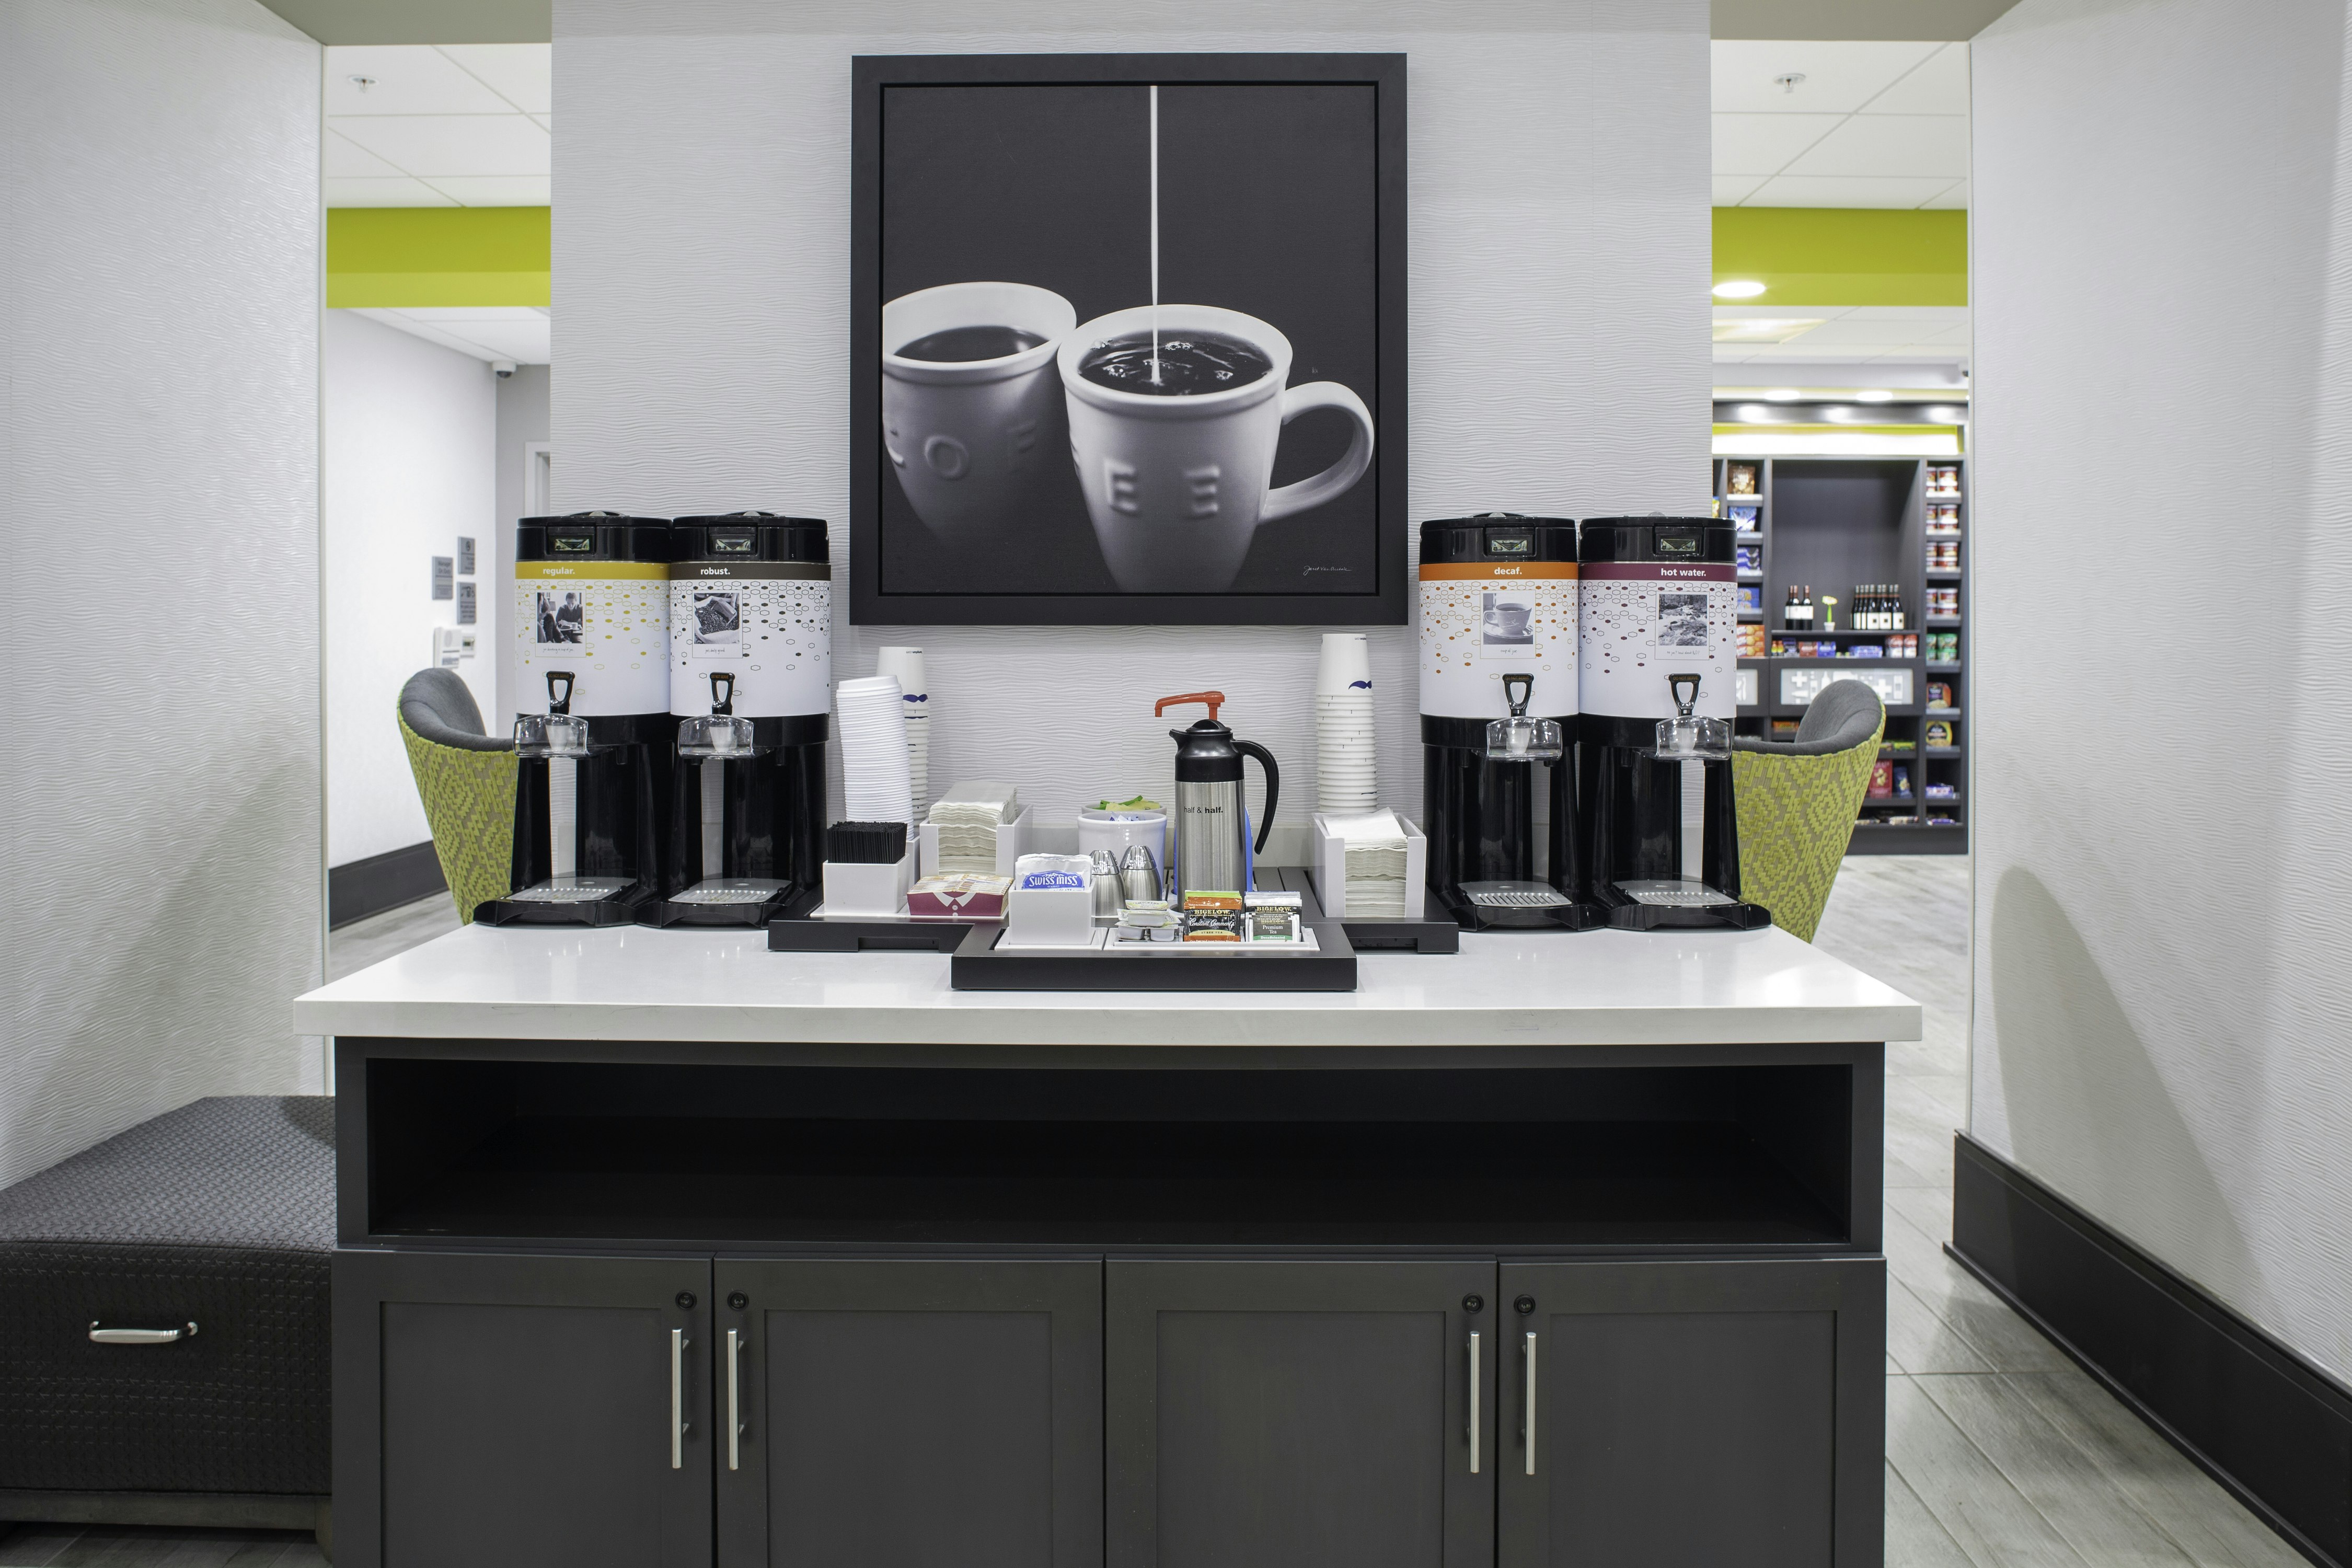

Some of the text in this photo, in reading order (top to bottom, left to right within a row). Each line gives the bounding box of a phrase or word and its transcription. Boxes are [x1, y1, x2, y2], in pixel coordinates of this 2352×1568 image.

[543, 567, 575, 576] regular.
[700, 567, 731, 575] robust.
[1494, 567, 1522, 575] decaf.
[1661, 568, 1678, 576] hot
[1029, 876, 1055, 887] SWISS
[1189, 918, 1209, 926] Constant
